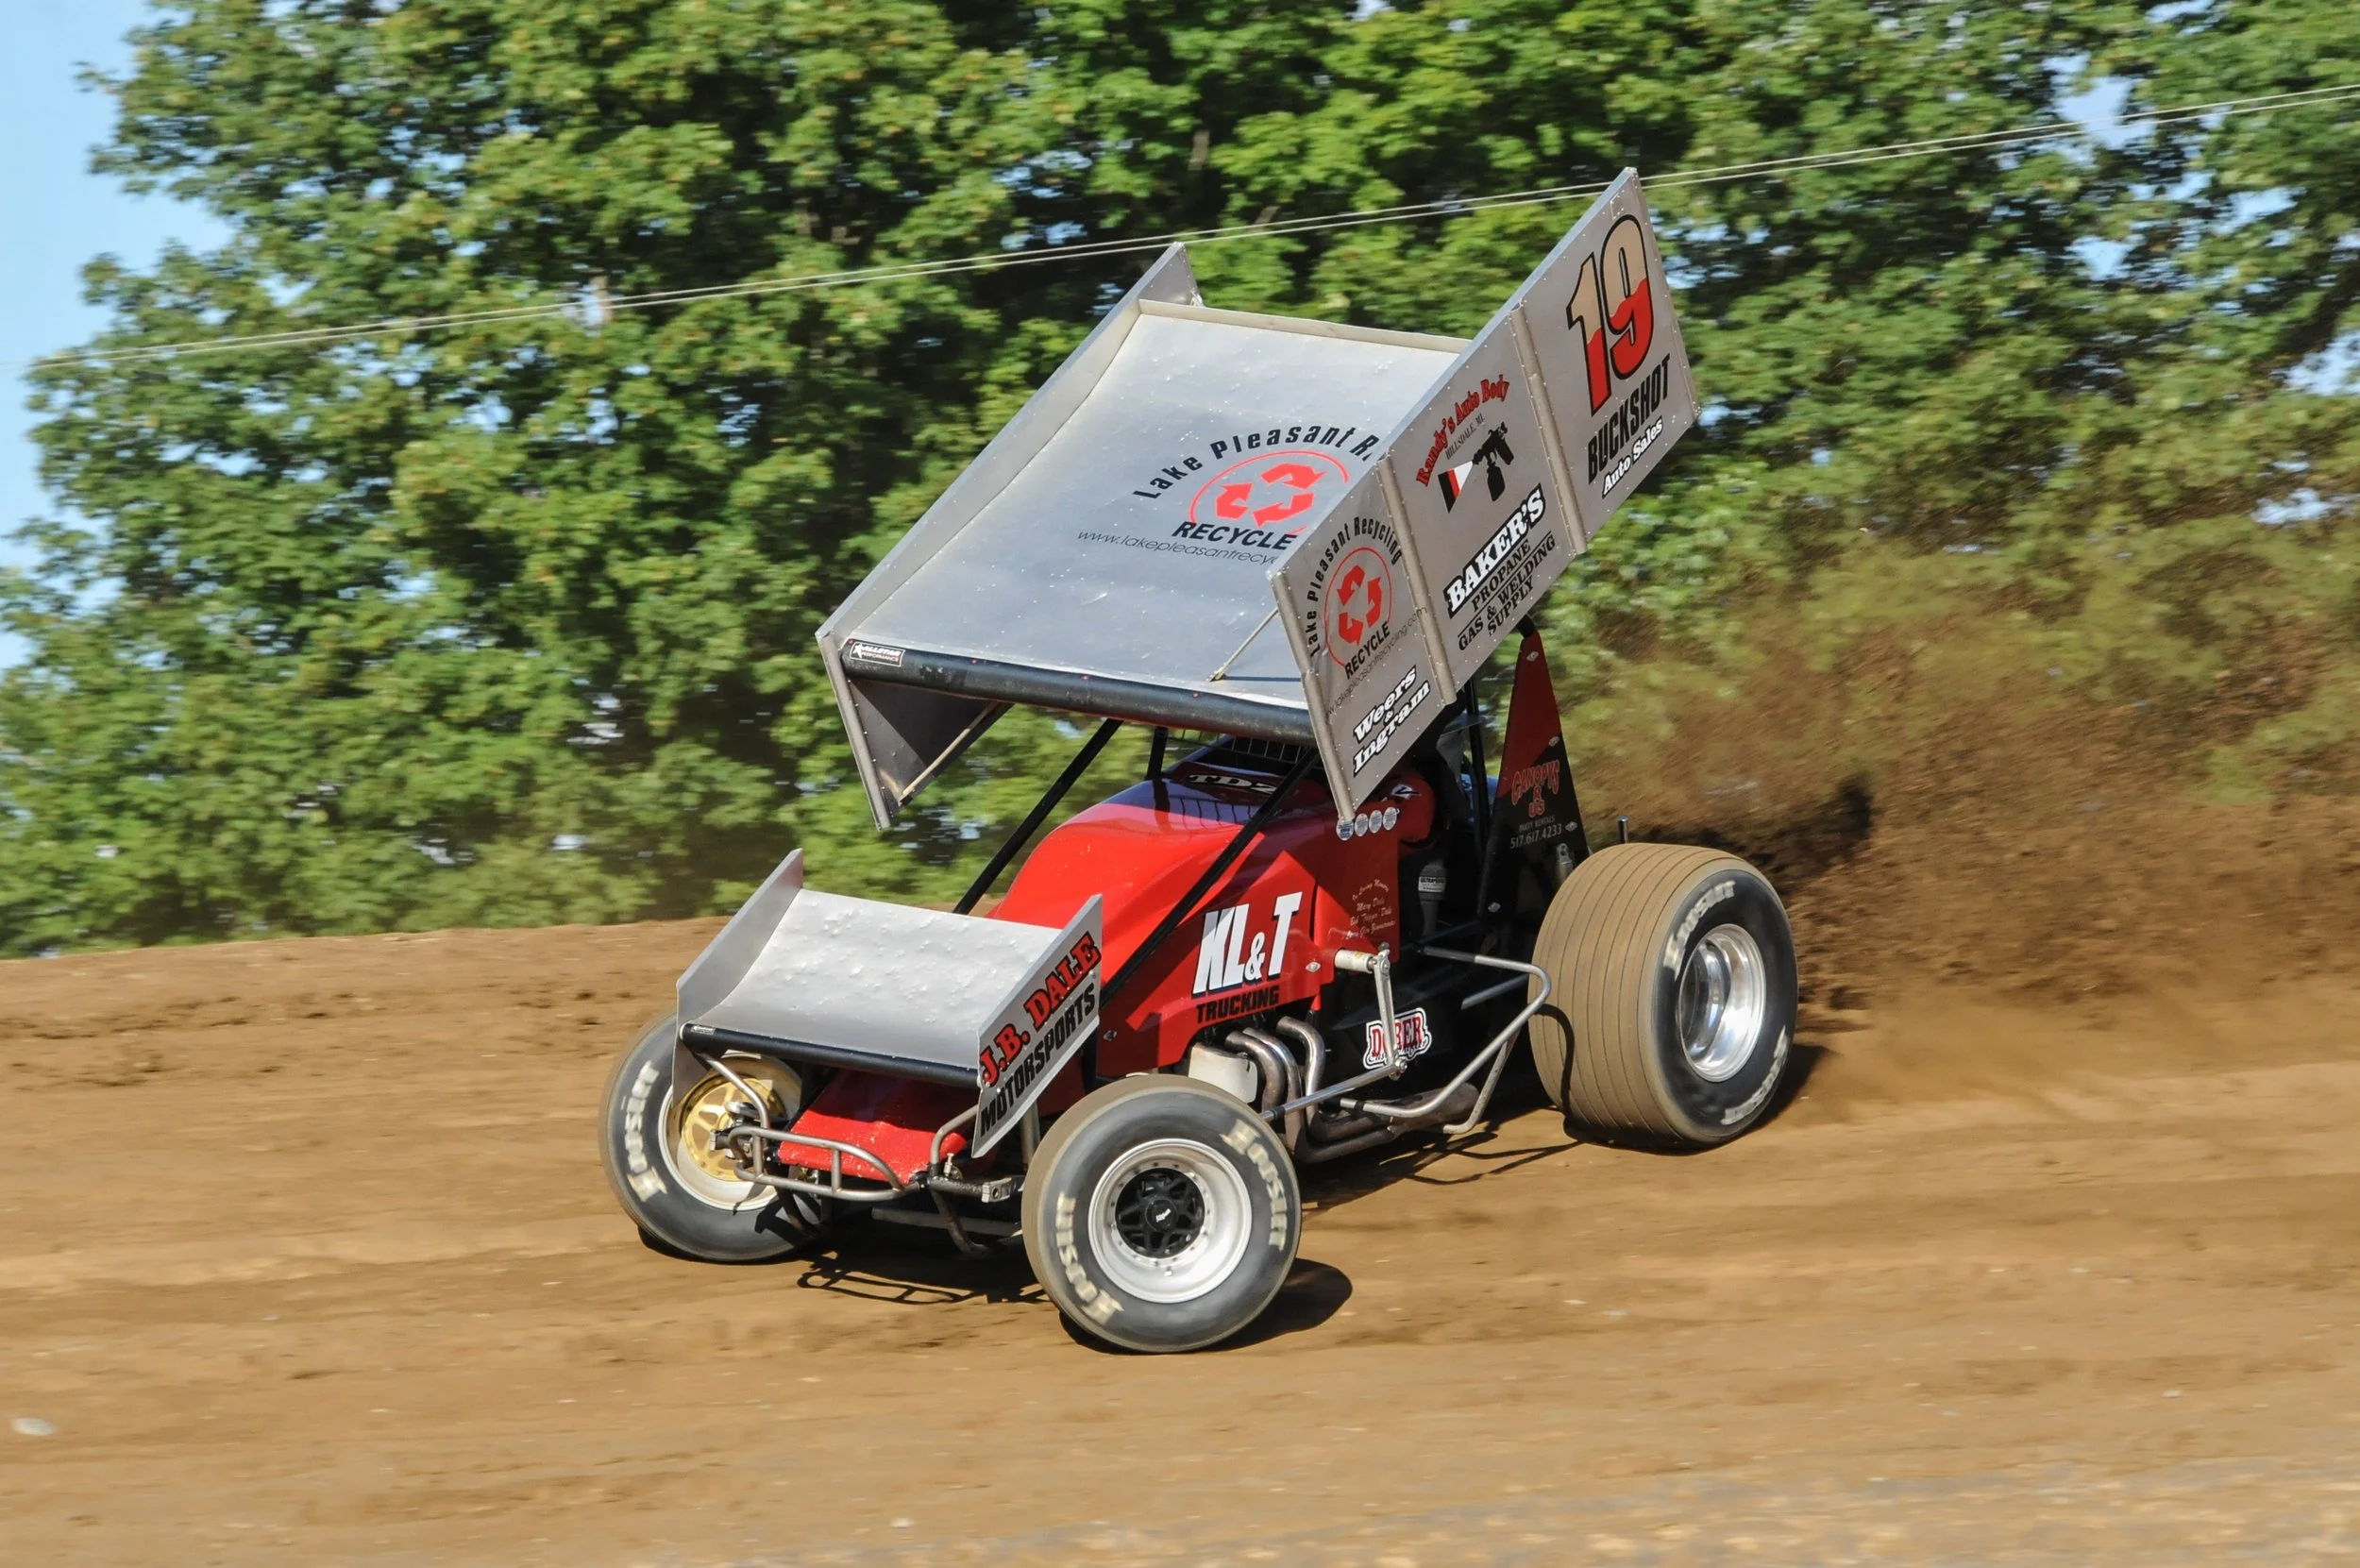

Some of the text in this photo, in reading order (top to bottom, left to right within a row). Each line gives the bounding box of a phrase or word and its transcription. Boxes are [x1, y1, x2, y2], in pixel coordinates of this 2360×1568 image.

[1566, 214, 1654, 416] 19
[1133, 455, 1203, 500] Lake
[1210, 426, 1355, 460] Pleasant
[1416, 374, 1509, 487] Randy's Auto Body
[1588, 353, 1670, 484] BUCKSHOT
[1602, 416, 1663, 498] Auto Sales
[1172, 521, 1297, 550] RECYCLE
[1444, 485, 1544, 616] BAKER'S
[1472, 539, 1531, 615] PROPANE
[1306, 516, 1403, 657] Lake Pleasant Recycling
[1458, 534, 1556, 651] GAS & WELDING
[1489, 577, 1535, 636] SUPPLY
[1344, 621, 1390, 679] RECYCLE
[1354, 665, 1416, 744] Weers
[1354, 680, 1430, 778] Ingram
[1510, 823, 1562, 850] 517.617.4233
[1192, 891, 1303, 997] KL&T
[980, 931, 1102, 1087] J.B. DALE
[1196, 985, 1280, 1024] TRUCKING
[1372, 1017, 1423, 1057] DBER
[981, 983, 1095, 1137] MOTORSPORTS
